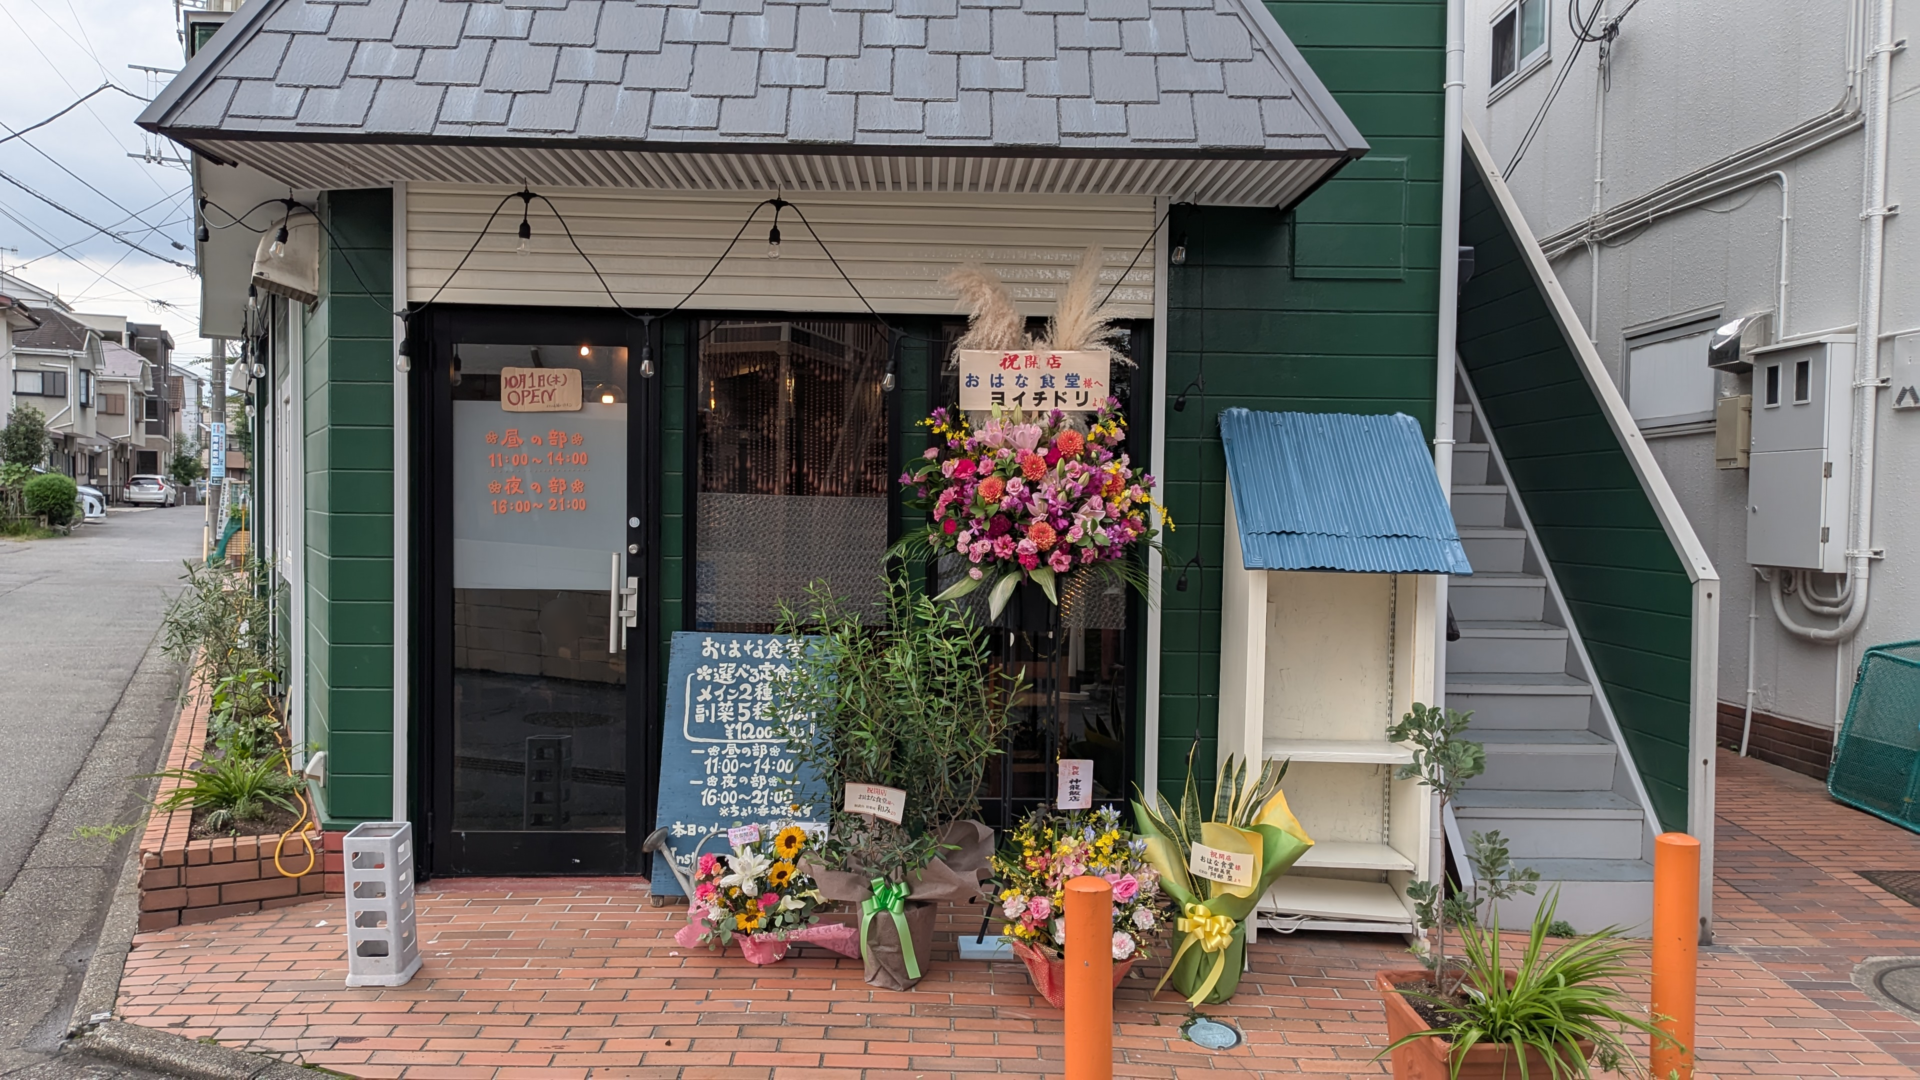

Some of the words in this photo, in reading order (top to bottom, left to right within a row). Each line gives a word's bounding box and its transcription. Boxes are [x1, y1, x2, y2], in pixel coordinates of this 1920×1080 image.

[999, 353, 1062, 371] 祝開店
[507, 388, 557, 406] OPEN
[501, 429, 568, 448] 昼の部
[504, 475, 567, 495] 夜の部
[702, 637, 804, 659] おはな食堂
[724, 743, 767, 758] 昼の部
[720, 774, 767, 789] 夜の部
[1210, 850, 1232, 861] 祝開店
